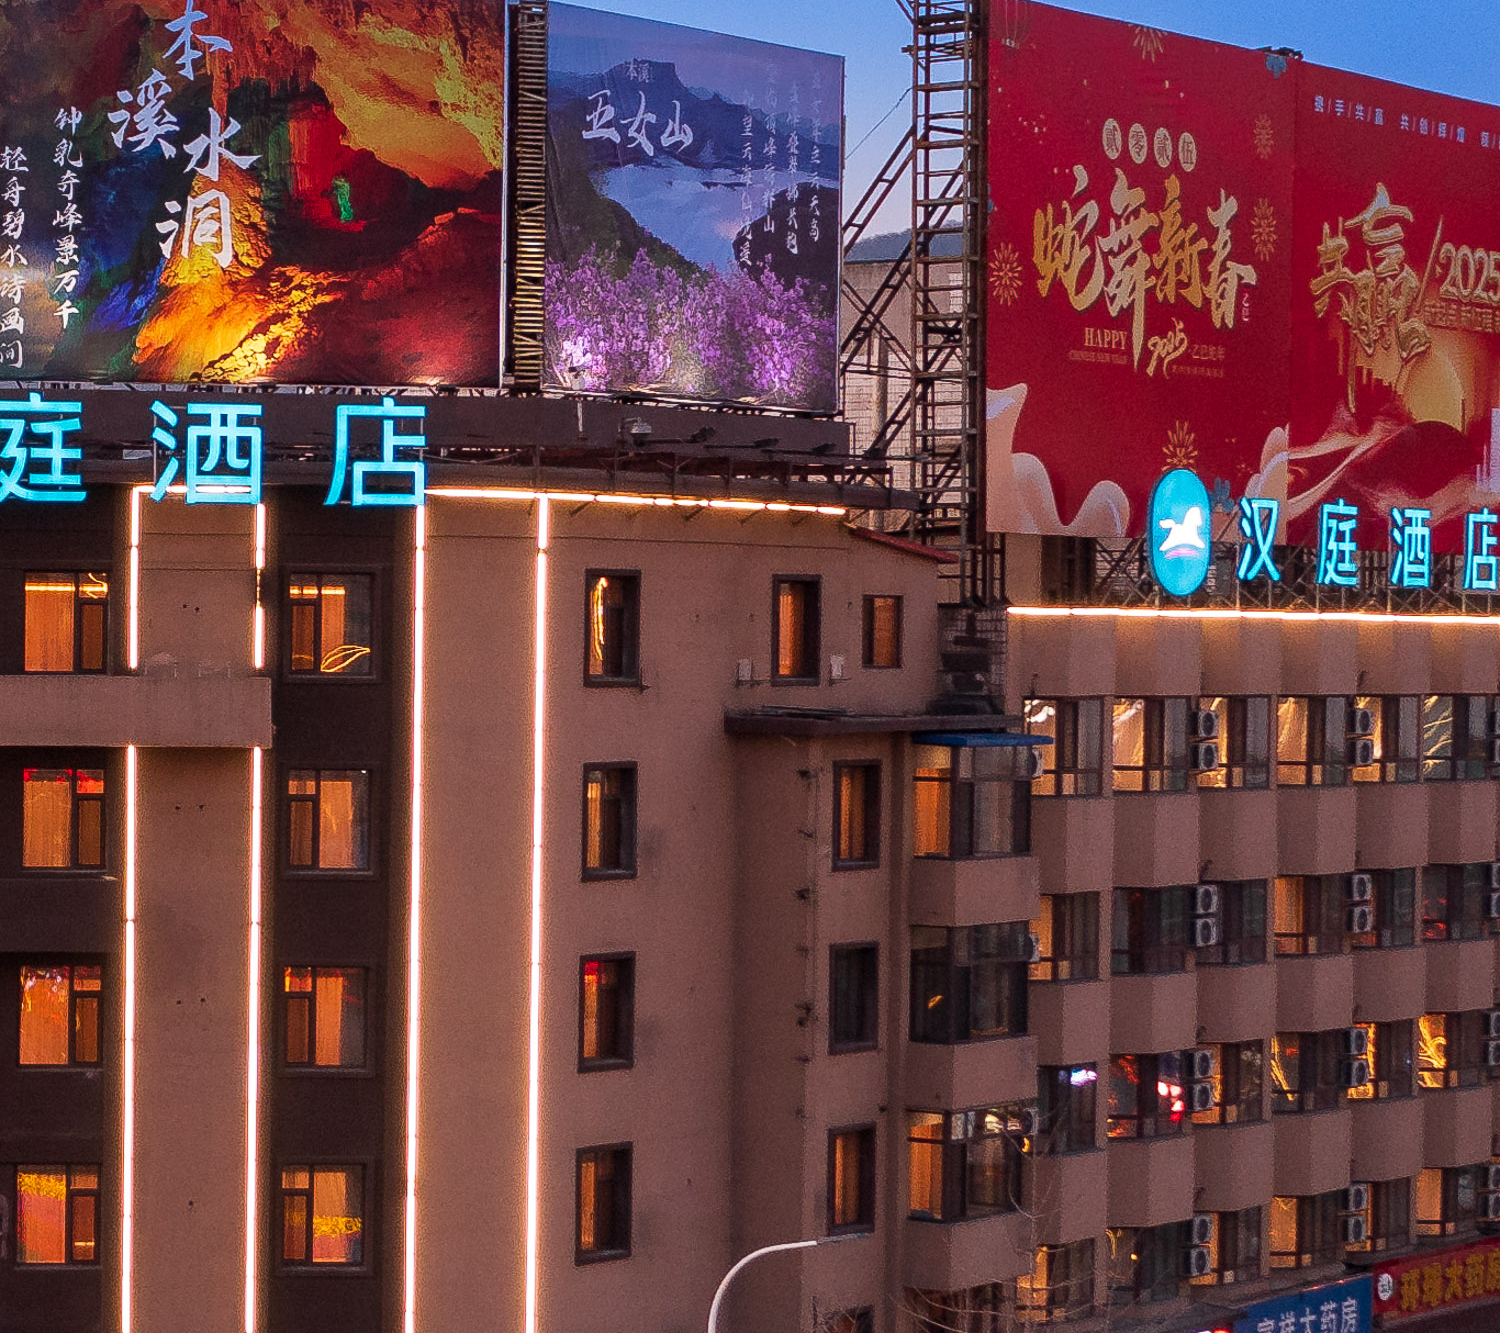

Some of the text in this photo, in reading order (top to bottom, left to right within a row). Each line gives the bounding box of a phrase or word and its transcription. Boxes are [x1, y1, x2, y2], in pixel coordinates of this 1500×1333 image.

[582, 88, 694, 157] 五女山
[51, 106, 83, 331] 钟乳奇峰景万千
[1032, 163, 1258, 371] 蛇舞新春
[1309, 182, 1432, 366] 共赢
[1084, 328, 1128, 350] HAPPY
[1237, 497, 1499, 591] 汉庭酒店
